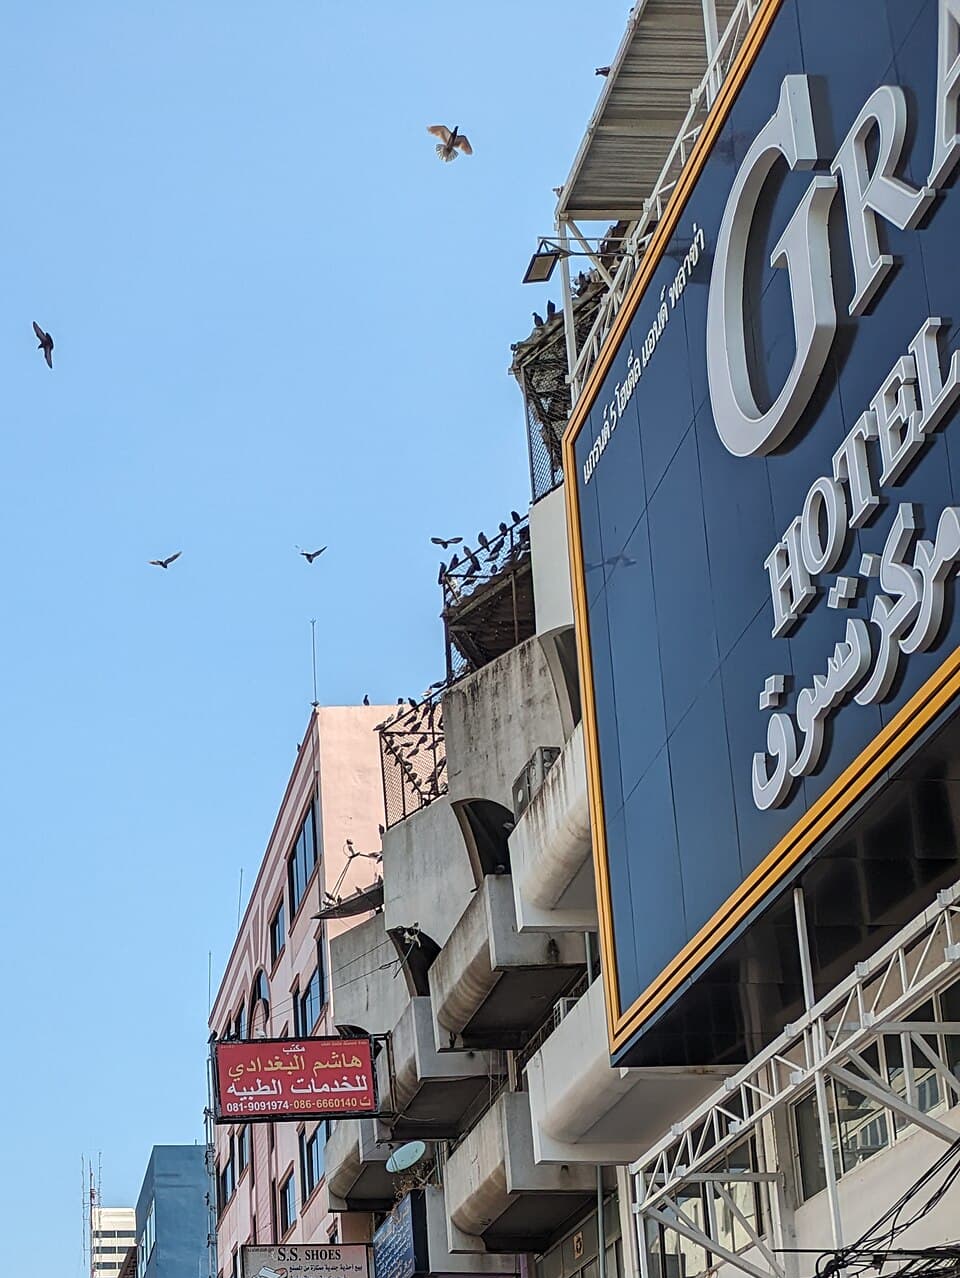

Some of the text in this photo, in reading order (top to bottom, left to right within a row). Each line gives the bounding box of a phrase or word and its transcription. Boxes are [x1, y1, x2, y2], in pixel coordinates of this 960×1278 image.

[763, 316, 960, 639] HOTEL
[282, 1044, 306, 1056] مكتب
[228, 1052, 362, 1082] هاشم البغدادي
[290, 1074, 368, 1094] للخدمات
[277, 1247, 302, 1262] S.S.
[305, 1249, 341, 1261] SHOES
